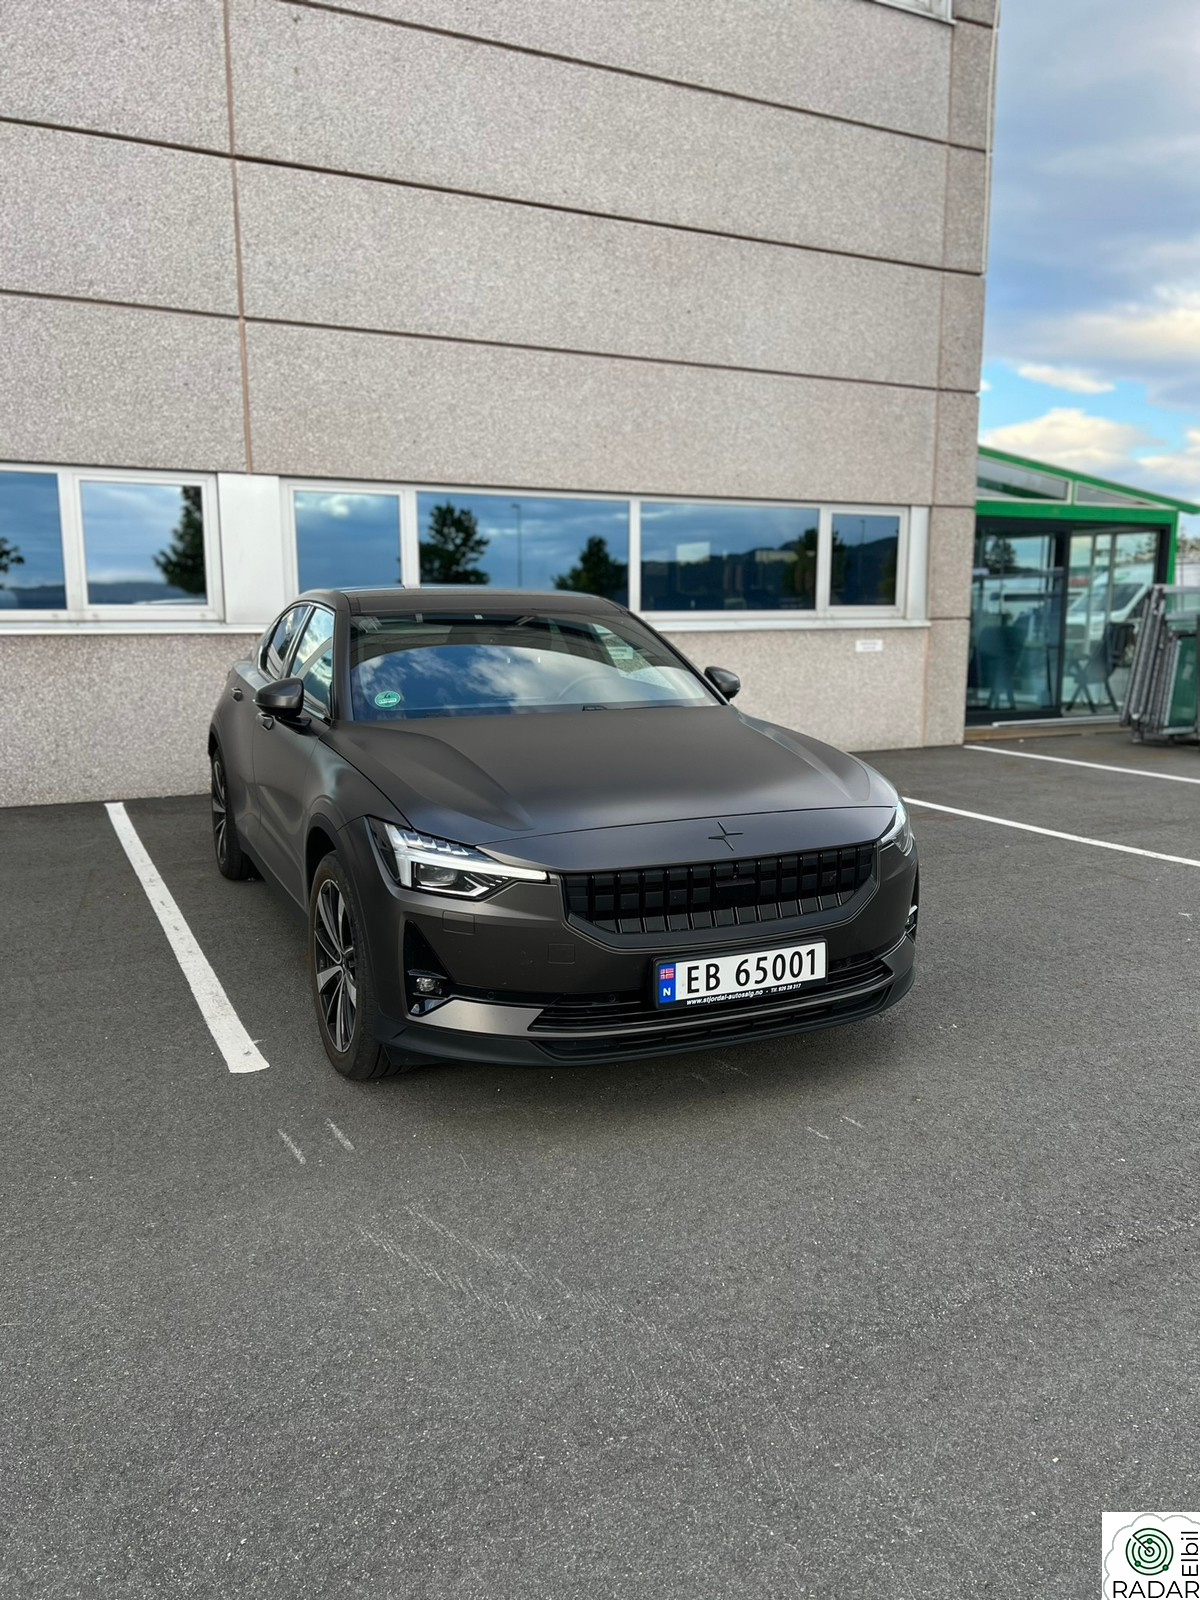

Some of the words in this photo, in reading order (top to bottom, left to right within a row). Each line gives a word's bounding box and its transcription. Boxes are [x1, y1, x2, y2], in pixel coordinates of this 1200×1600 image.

[687, 963, 720, 994] EB
[735, 948, 815, 987] 65001
[663, 987, 671, 996] N
